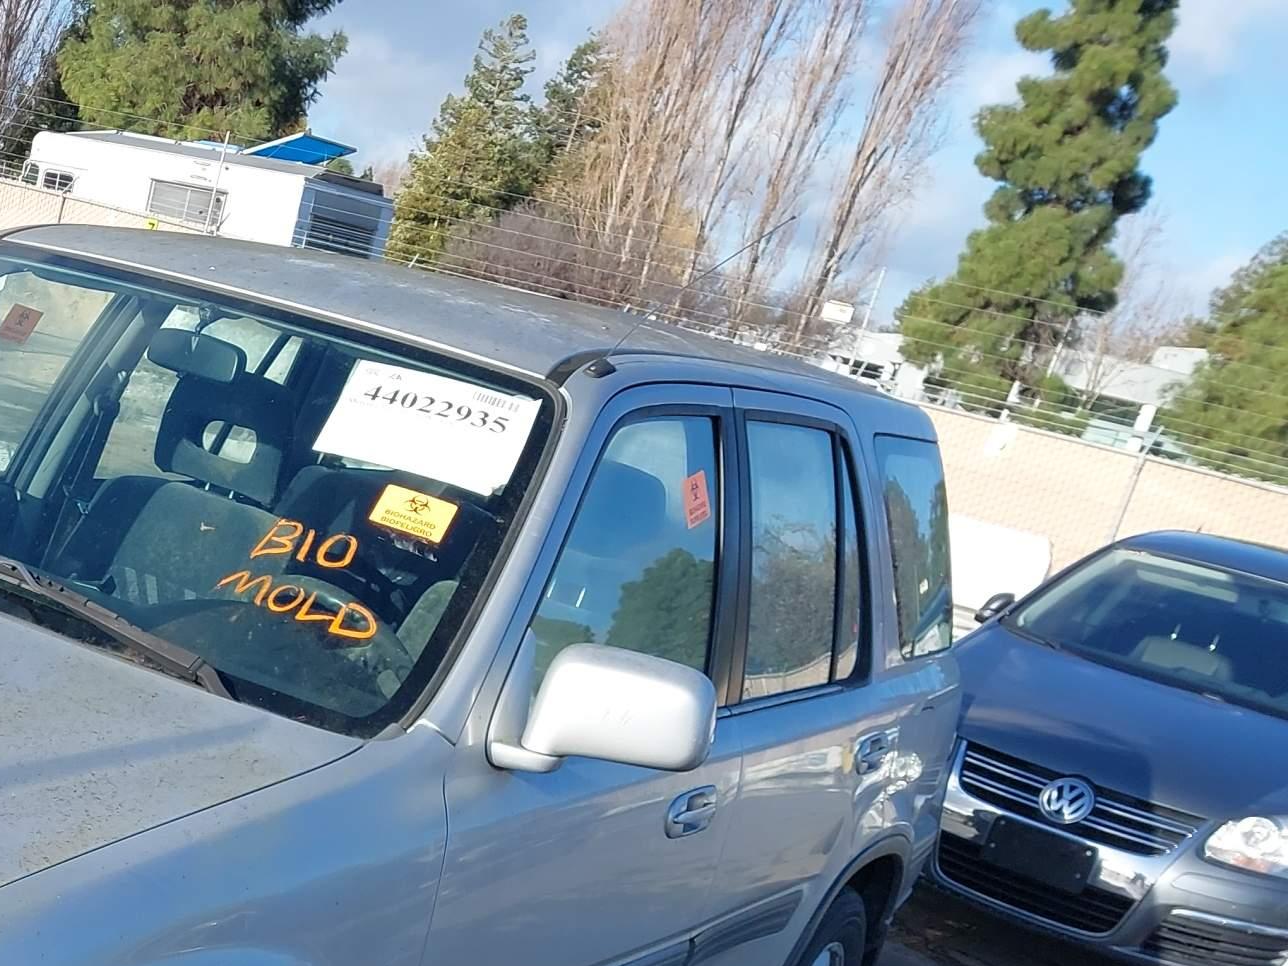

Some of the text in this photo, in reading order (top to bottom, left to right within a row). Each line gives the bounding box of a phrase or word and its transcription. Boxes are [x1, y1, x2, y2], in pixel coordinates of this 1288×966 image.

[363, 385, 510, 433] 44022935
[250, 518, 359, 568] BIO
[380, 516, 432, 537] BIOPELIGRO
[384, 509, 436, 530] BIOHAZARD
[214, 570, 377, 639] MOLD
